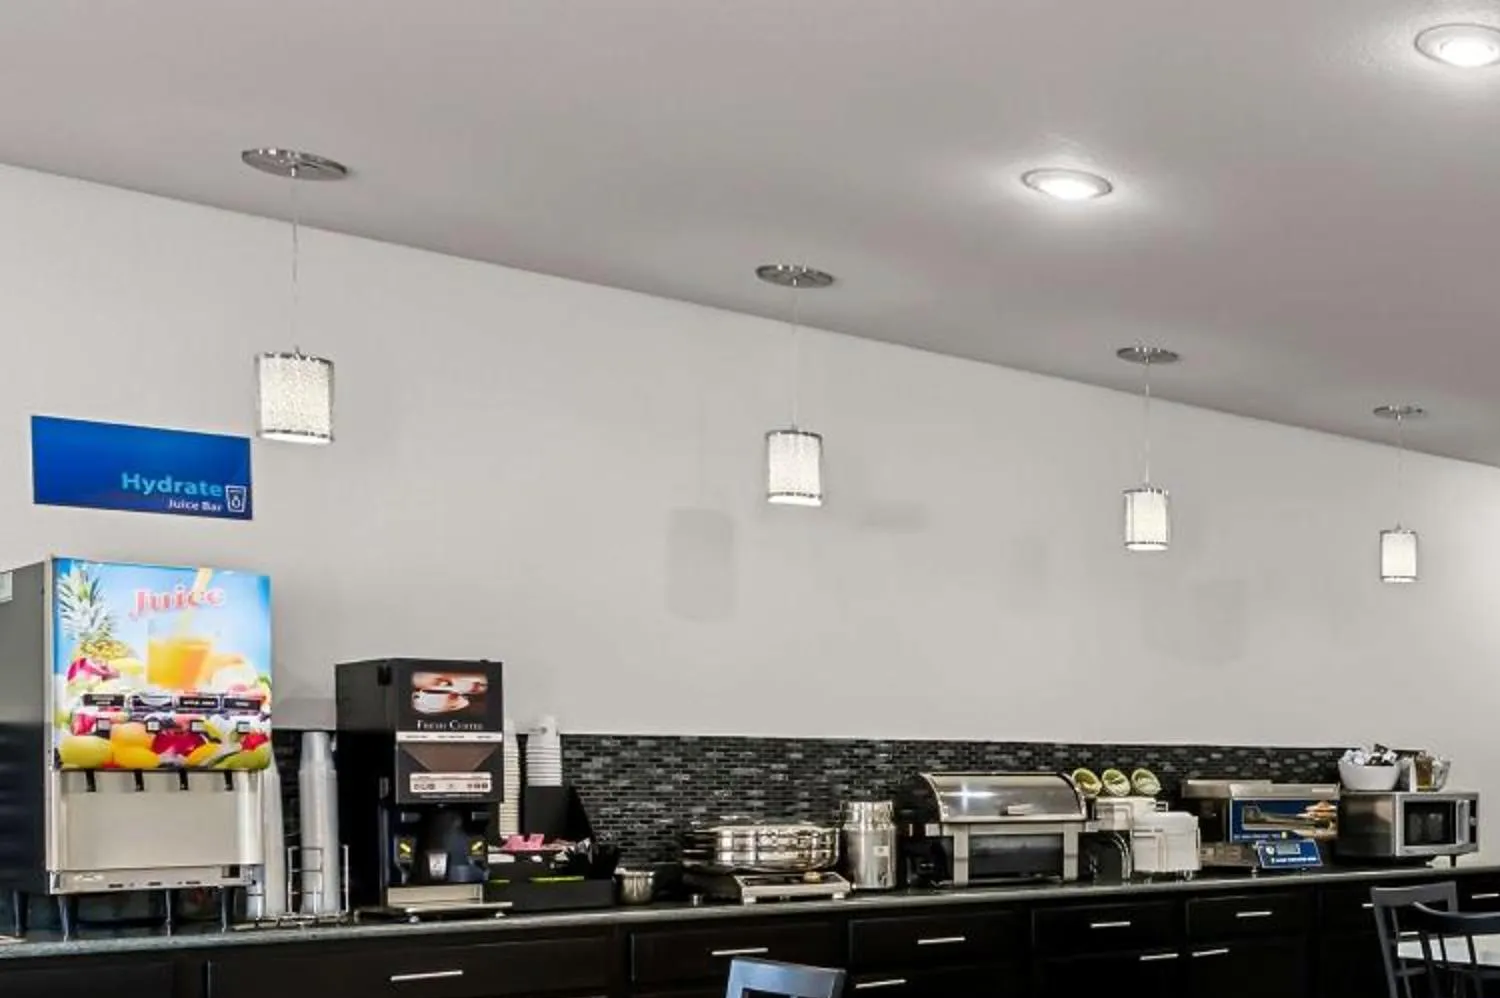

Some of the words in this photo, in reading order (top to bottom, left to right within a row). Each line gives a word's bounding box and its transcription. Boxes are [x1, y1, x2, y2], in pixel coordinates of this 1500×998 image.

[121, 472, 223, 497] Hydrate
[168, 499, 199, 511] Juice
[201, 501, 222, 512] Bar
